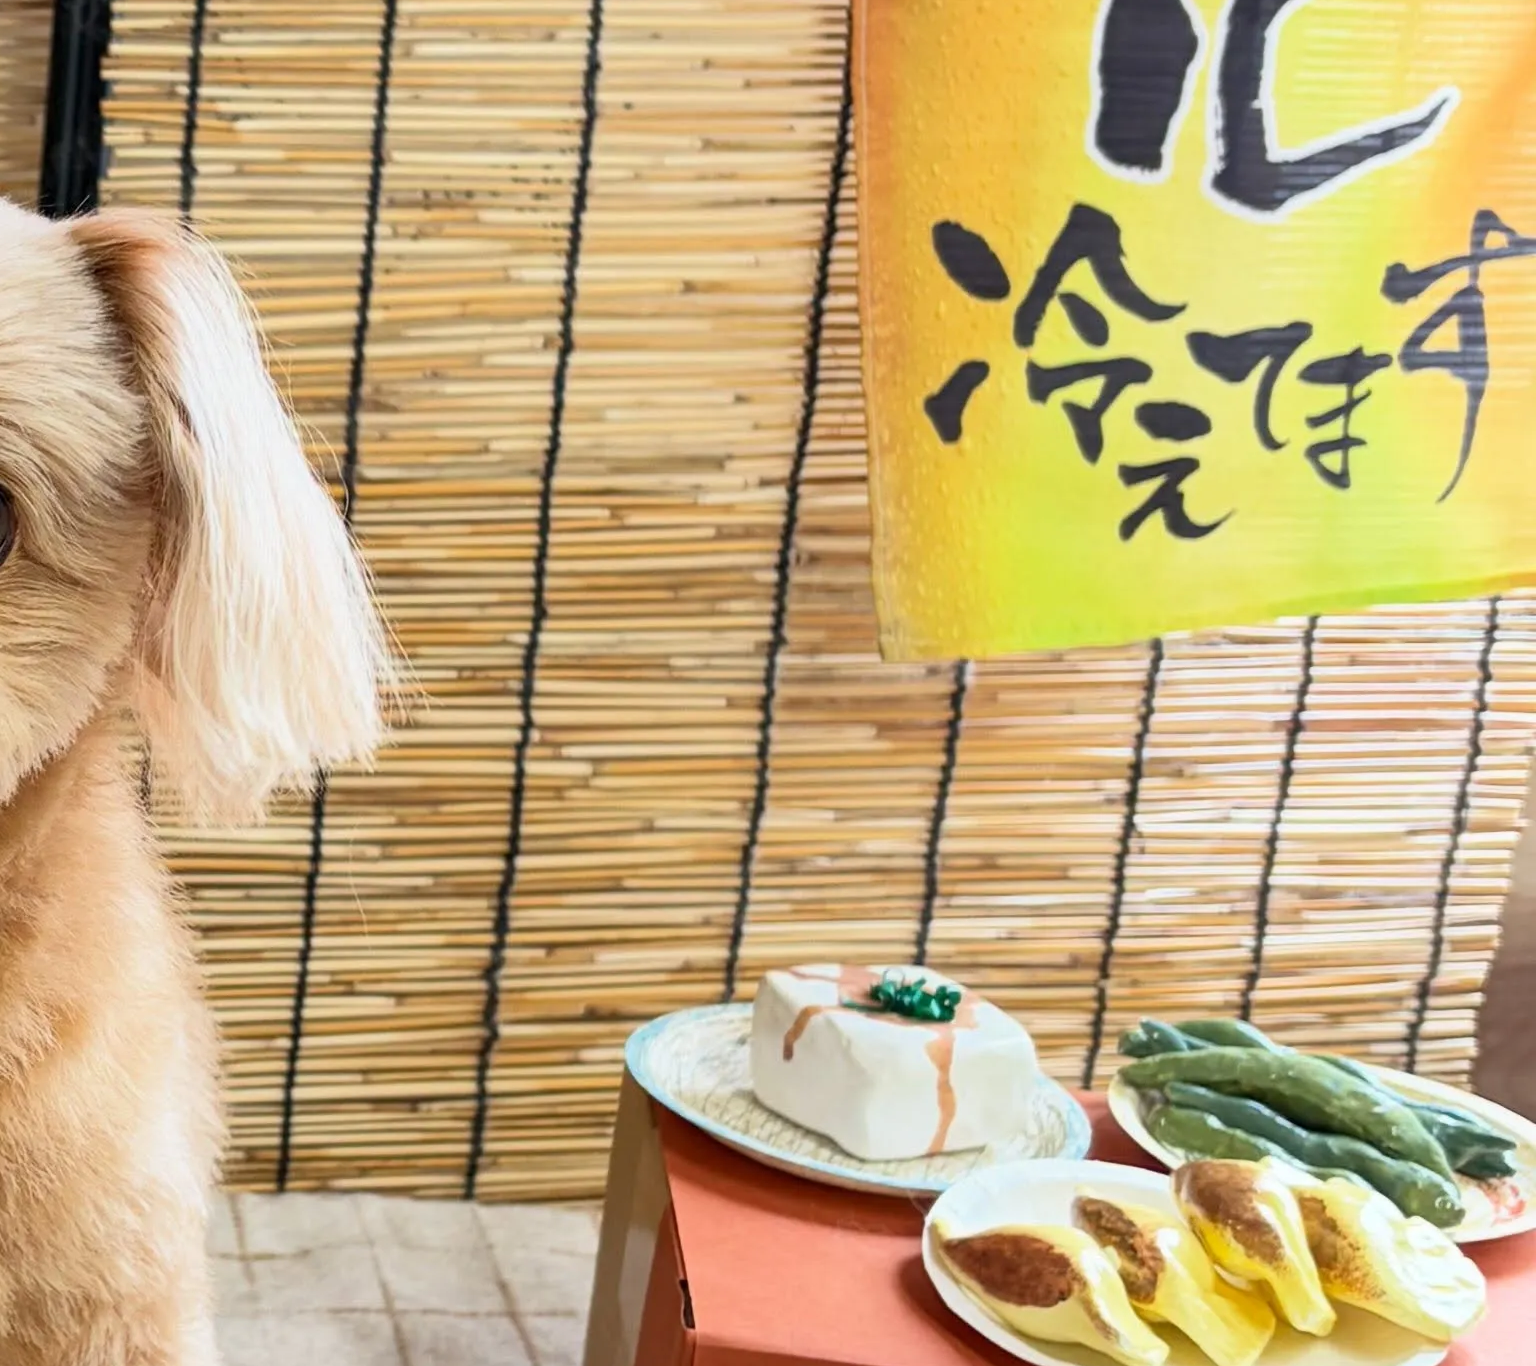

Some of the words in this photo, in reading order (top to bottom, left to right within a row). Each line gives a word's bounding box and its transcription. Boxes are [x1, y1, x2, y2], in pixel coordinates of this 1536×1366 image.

[922, 201, 1536, 541] 冷えてます
